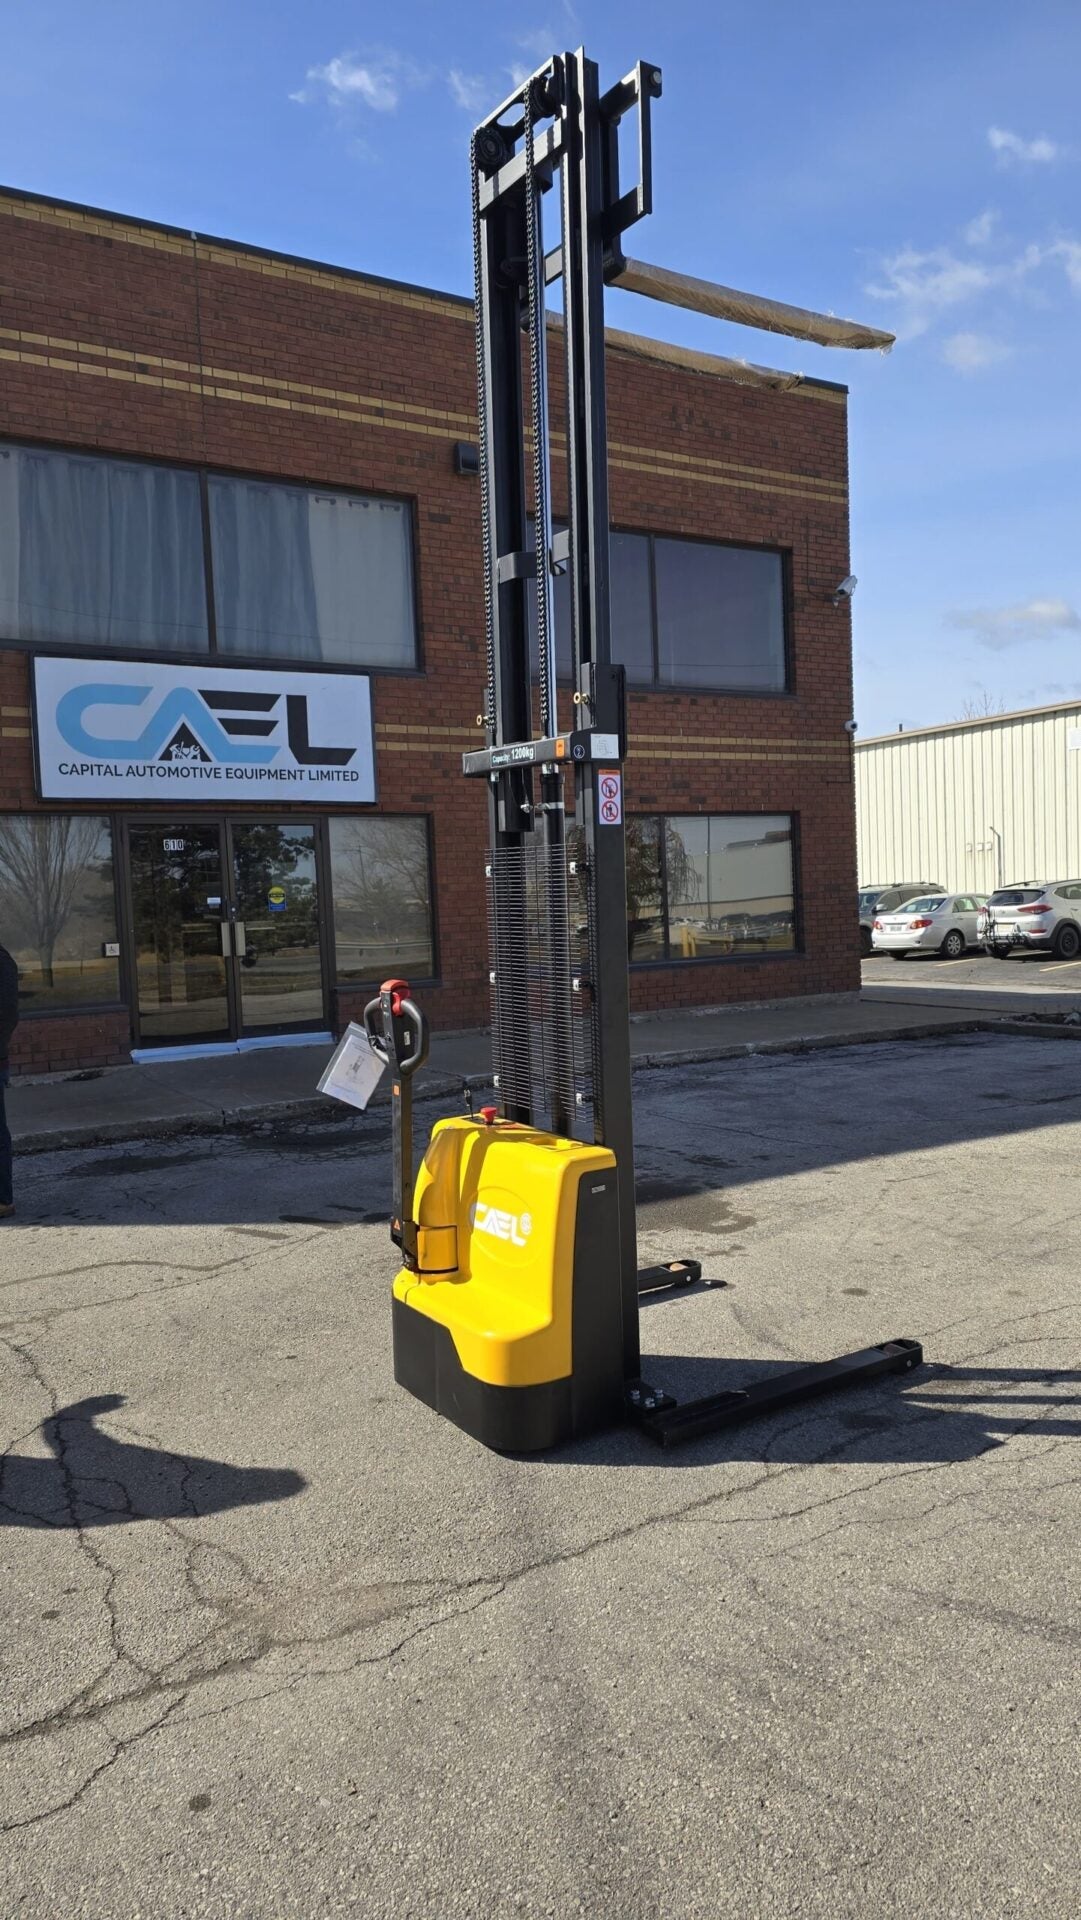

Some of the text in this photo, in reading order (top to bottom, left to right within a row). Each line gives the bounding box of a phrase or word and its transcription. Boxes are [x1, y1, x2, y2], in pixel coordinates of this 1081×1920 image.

[56, 683, 357, 766] CAEL
[511, 746, 534, 760] 1200kg
[58, 763, 359, 782] CAPITAL AUTOMOTIVE EQUIPMENT LIMITED
[164, 840, 183, 850] 610
[470, 1202, 527, 1247] CAEL
